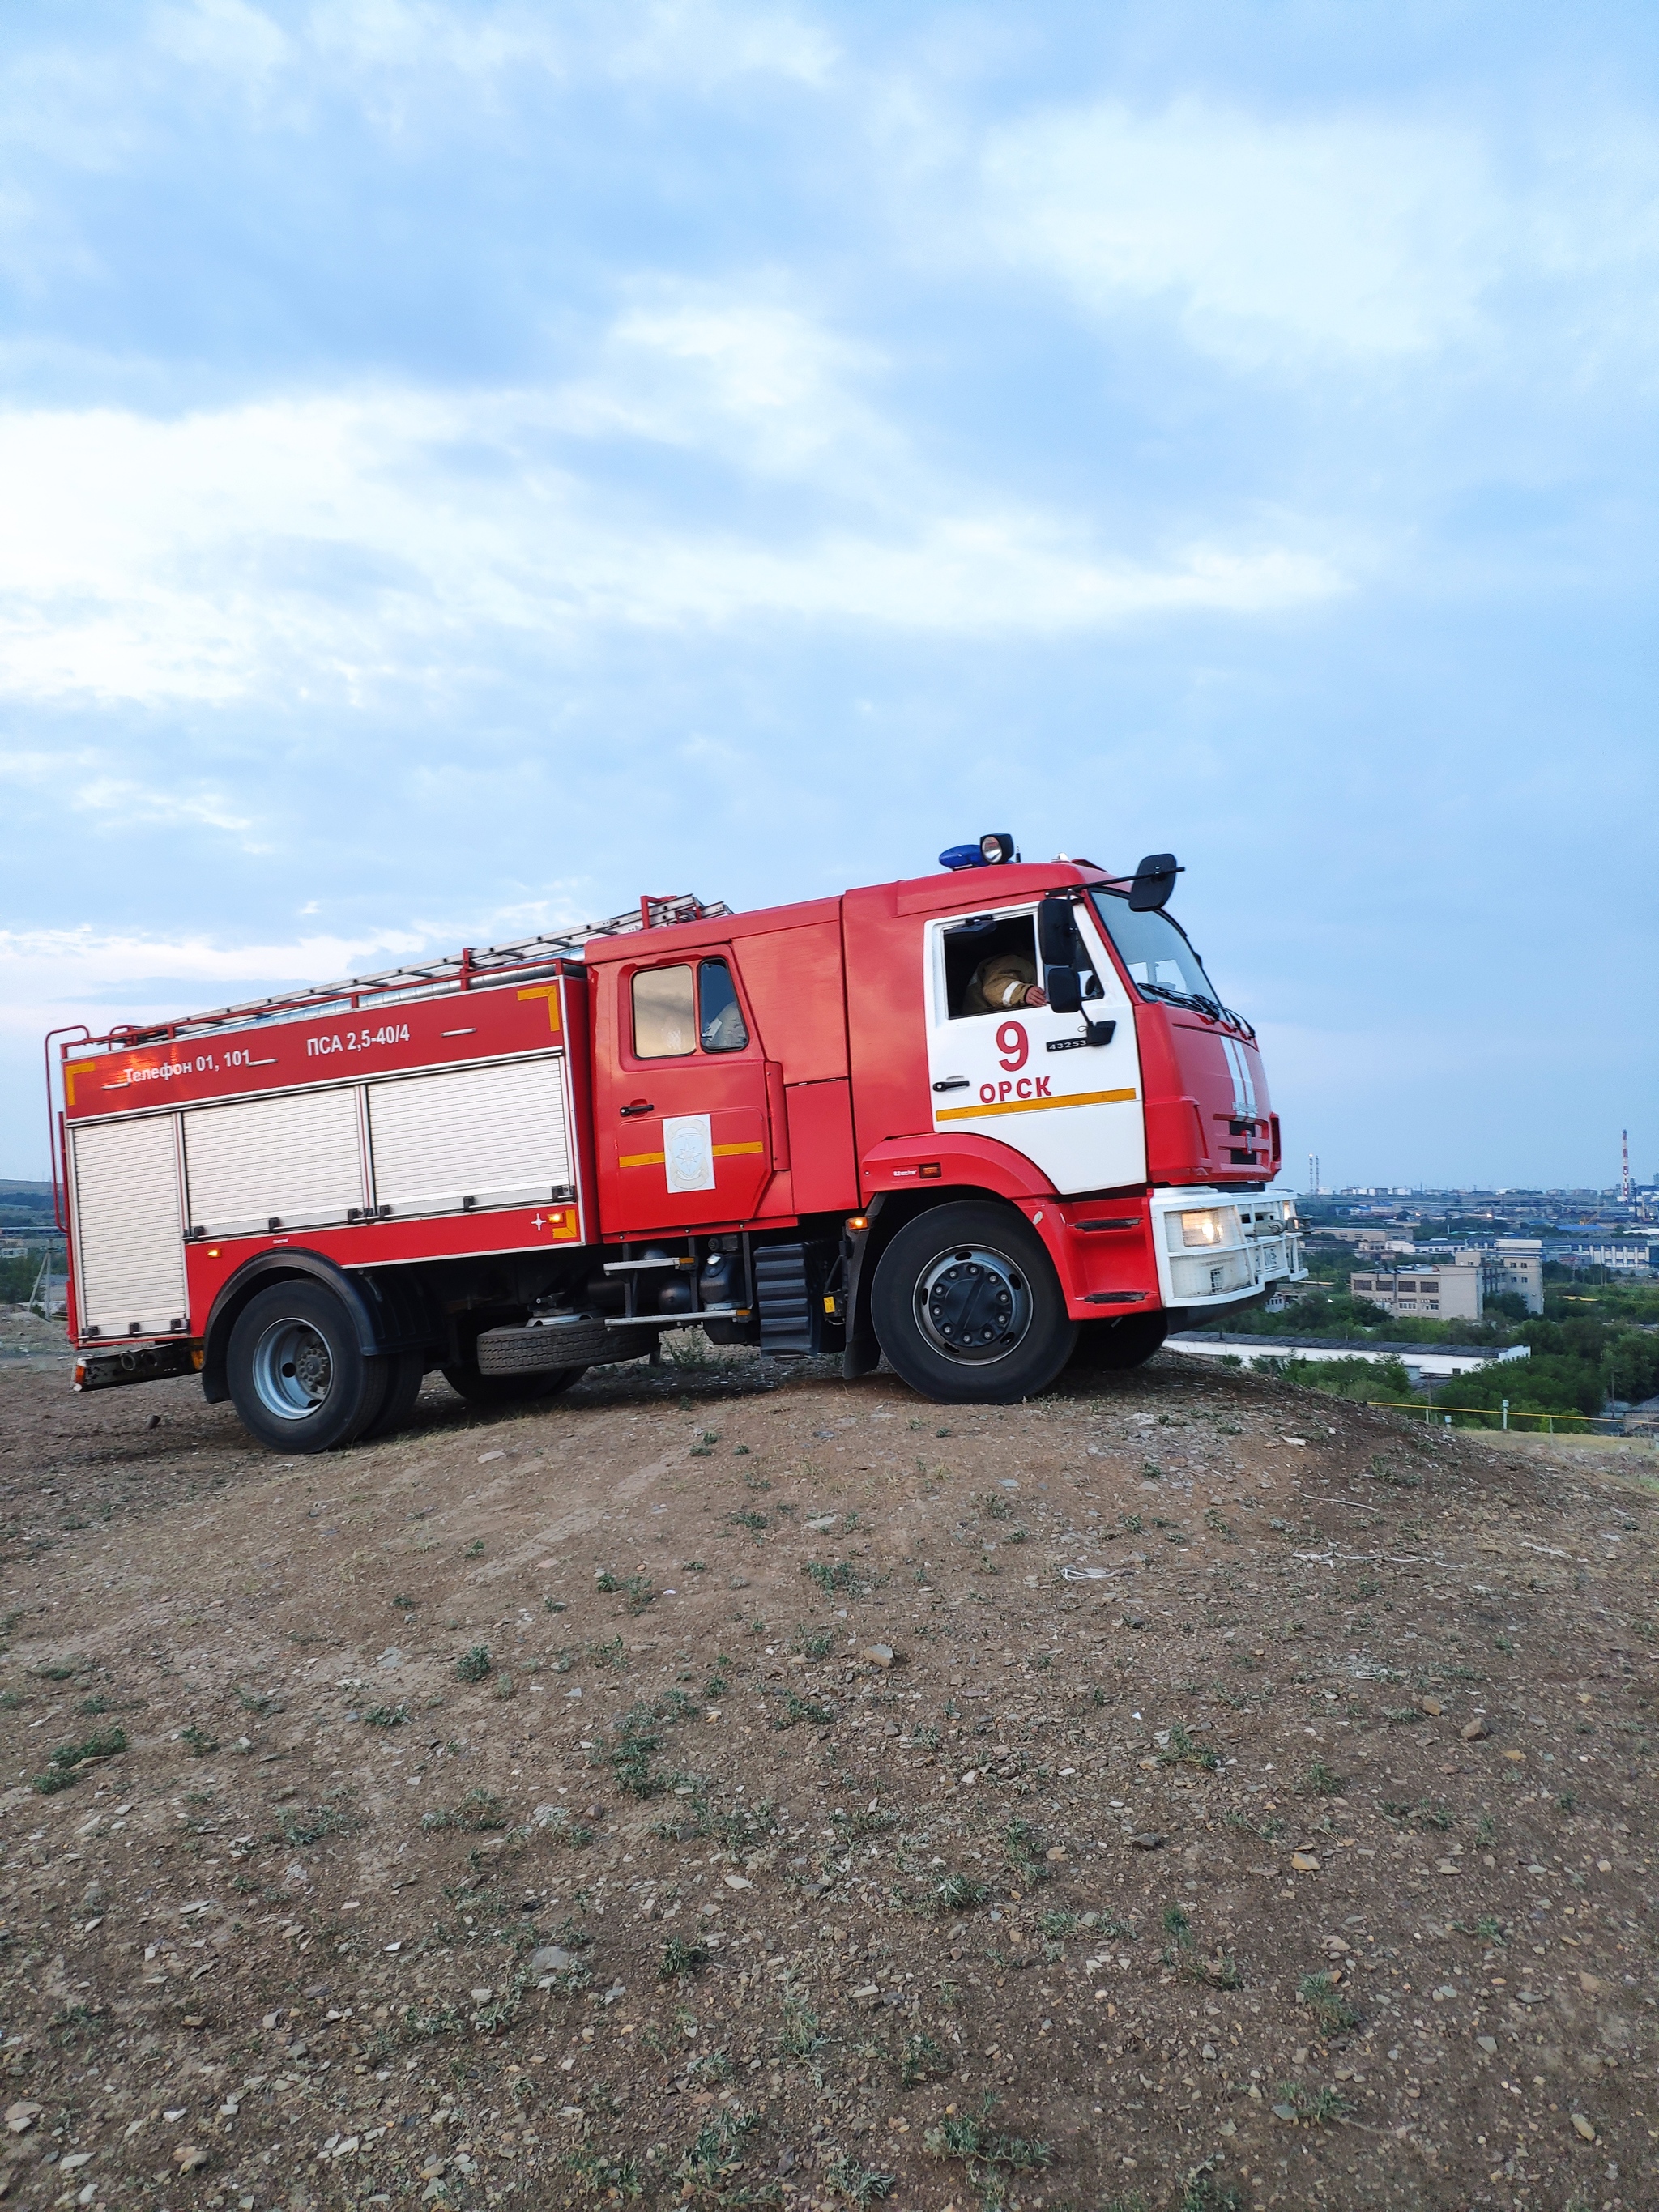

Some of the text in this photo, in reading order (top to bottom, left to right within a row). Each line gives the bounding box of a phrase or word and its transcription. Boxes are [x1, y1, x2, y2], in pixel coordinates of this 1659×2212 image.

[307, 1024, 410, 1056] ПСА 2,5-40/4
[996, 1021, 1029, 1072] 9
[1048, 1040, 1087, 1050] 43253
[123, 1049, 250, 1082] Телефон 01, 101
[979, 1076, 1051, 1104] ОРСК
